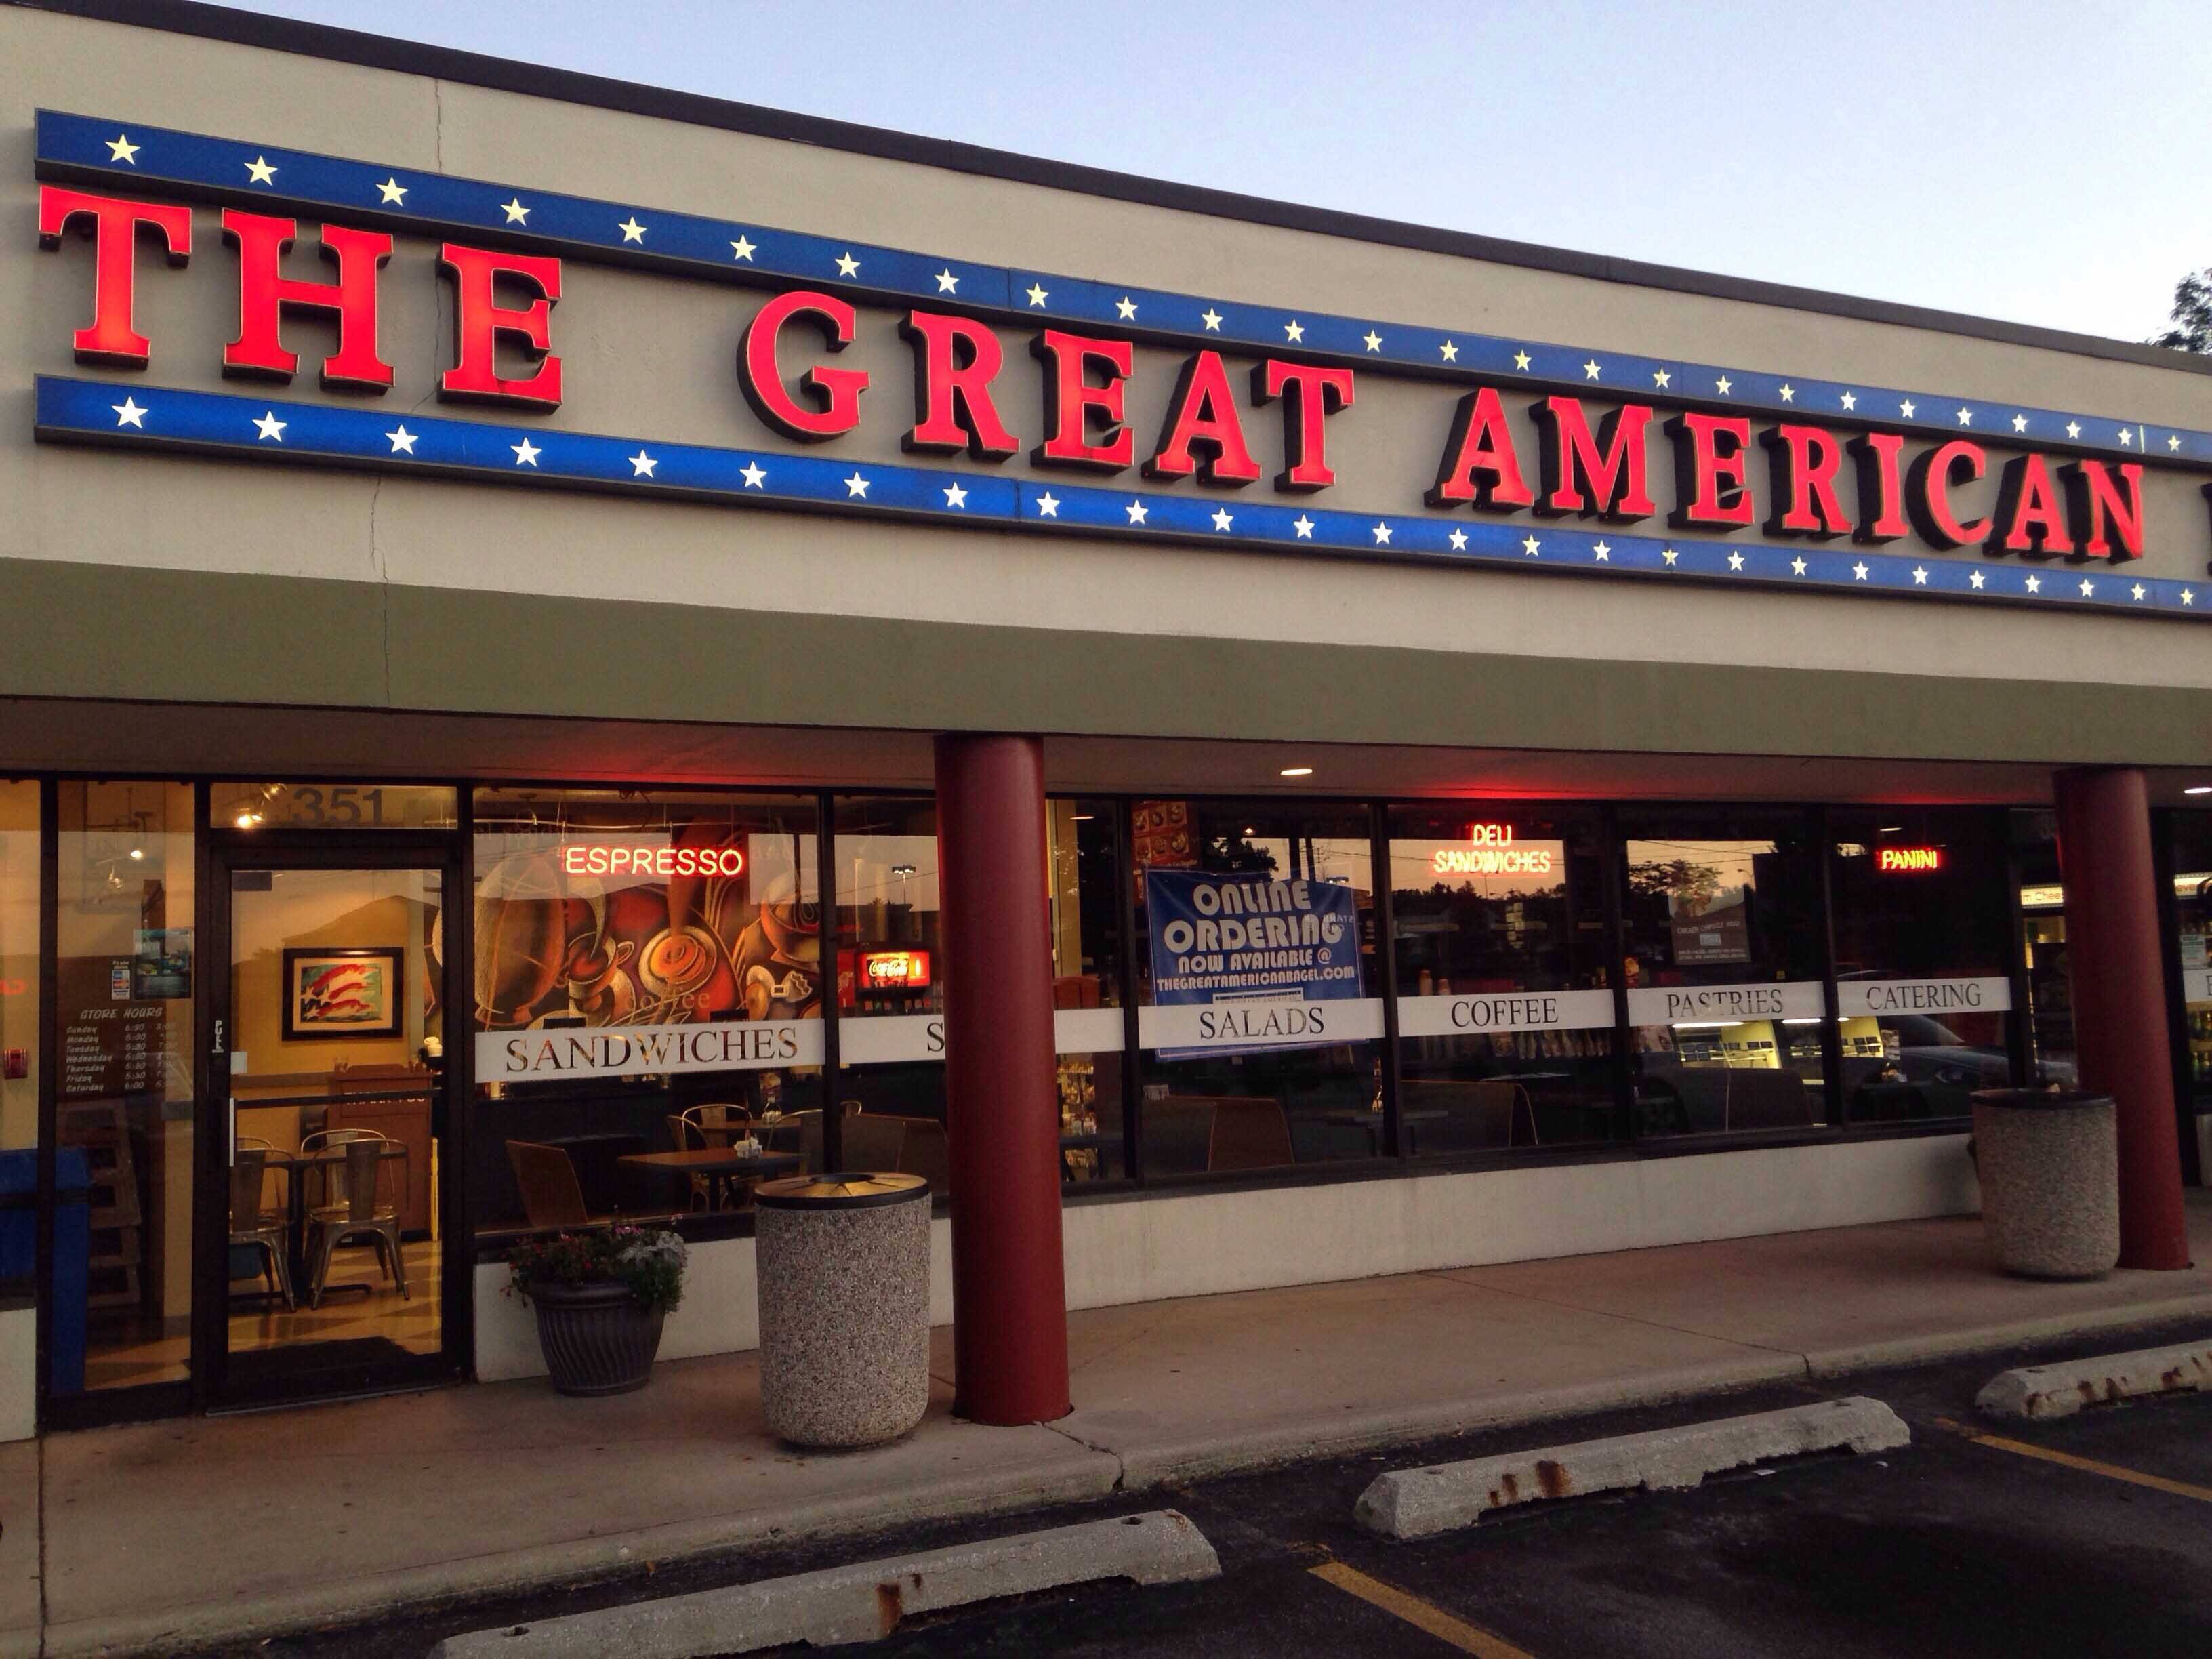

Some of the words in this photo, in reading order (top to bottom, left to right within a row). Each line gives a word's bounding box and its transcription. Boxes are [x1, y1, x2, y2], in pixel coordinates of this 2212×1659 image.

[38, 185, 563, 408] THE
[740, 290, 1354, 488] GREAT
[1430, 387, 2144, 560] AMERICAN
[293, 787, 382, 825] 351
[1473, 824, 1513, 846] DELI
[565, 847, 743, 876] ESPRESSO
[1433, 851, 1551, 874] SANDWICHES
[1881, 849, 1938, 869] PANINI
[1193, 881, 1312, 915] ONLINE
[1164, 913, 1343, 954] ORDERING
[1178, 954, 1224, 974] NOW
[1230, 949, 1313, 971] AVAILABLE
[1317, 948, 1332, 965] @
[1157, 966, 1355, 992] THEGREATAMERICANBAGEL.COM
[1666, 989, 1784, 1018] PASTRIES
[1866, 983, 1982, 1010] CATERING
[80, 1008, 119, 1020] STORE
[123, 1007, 163, 1019] HOURS
[1200, 1006, 1325, 1040] SALADS
[1451, 998, 1559, 1028] COFFEE
[506, 1027, 798, 1073] SANDWICHES
